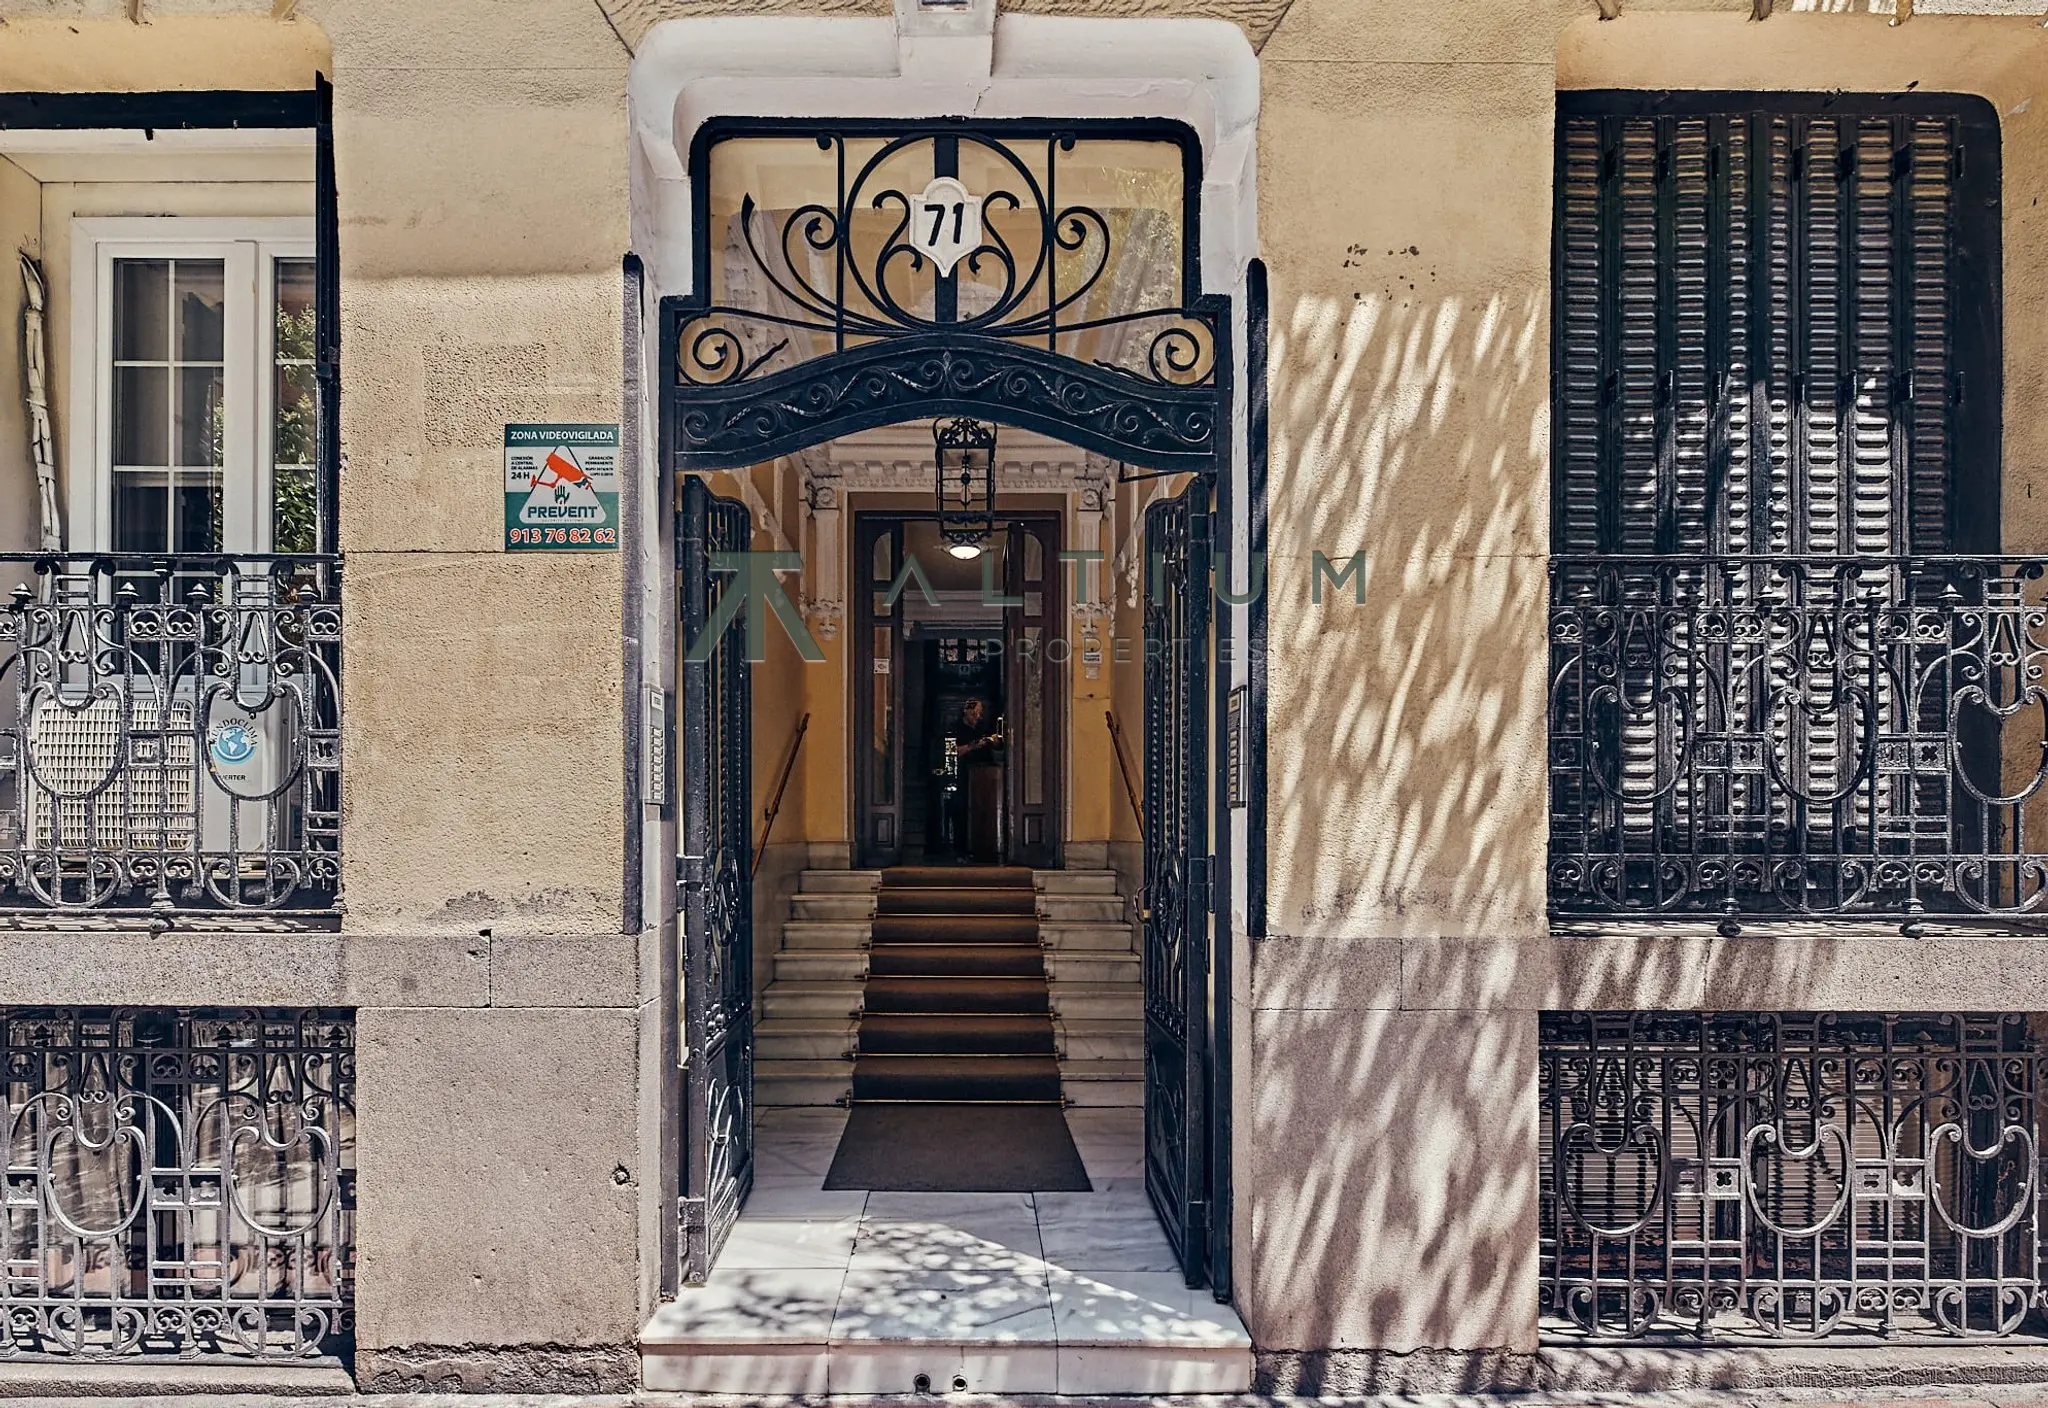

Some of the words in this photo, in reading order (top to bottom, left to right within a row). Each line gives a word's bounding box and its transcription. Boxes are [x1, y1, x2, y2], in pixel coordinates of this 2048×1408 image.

[924, 202, 965, 247] 71
[511, 431, 538, 440] ZONA
[539, 431, 614, 440] VIDEOVIGILADA
[511, 471, 522, 480] 24
[523, 471, 530, 480] H
[527, 506, 598, 518] PREVENT
[509, 528, 542, 544] 913
[545, 528, 567, 544] 76
[569, 528, 591, 544] 82
[593, 528, 616, 544] 62
